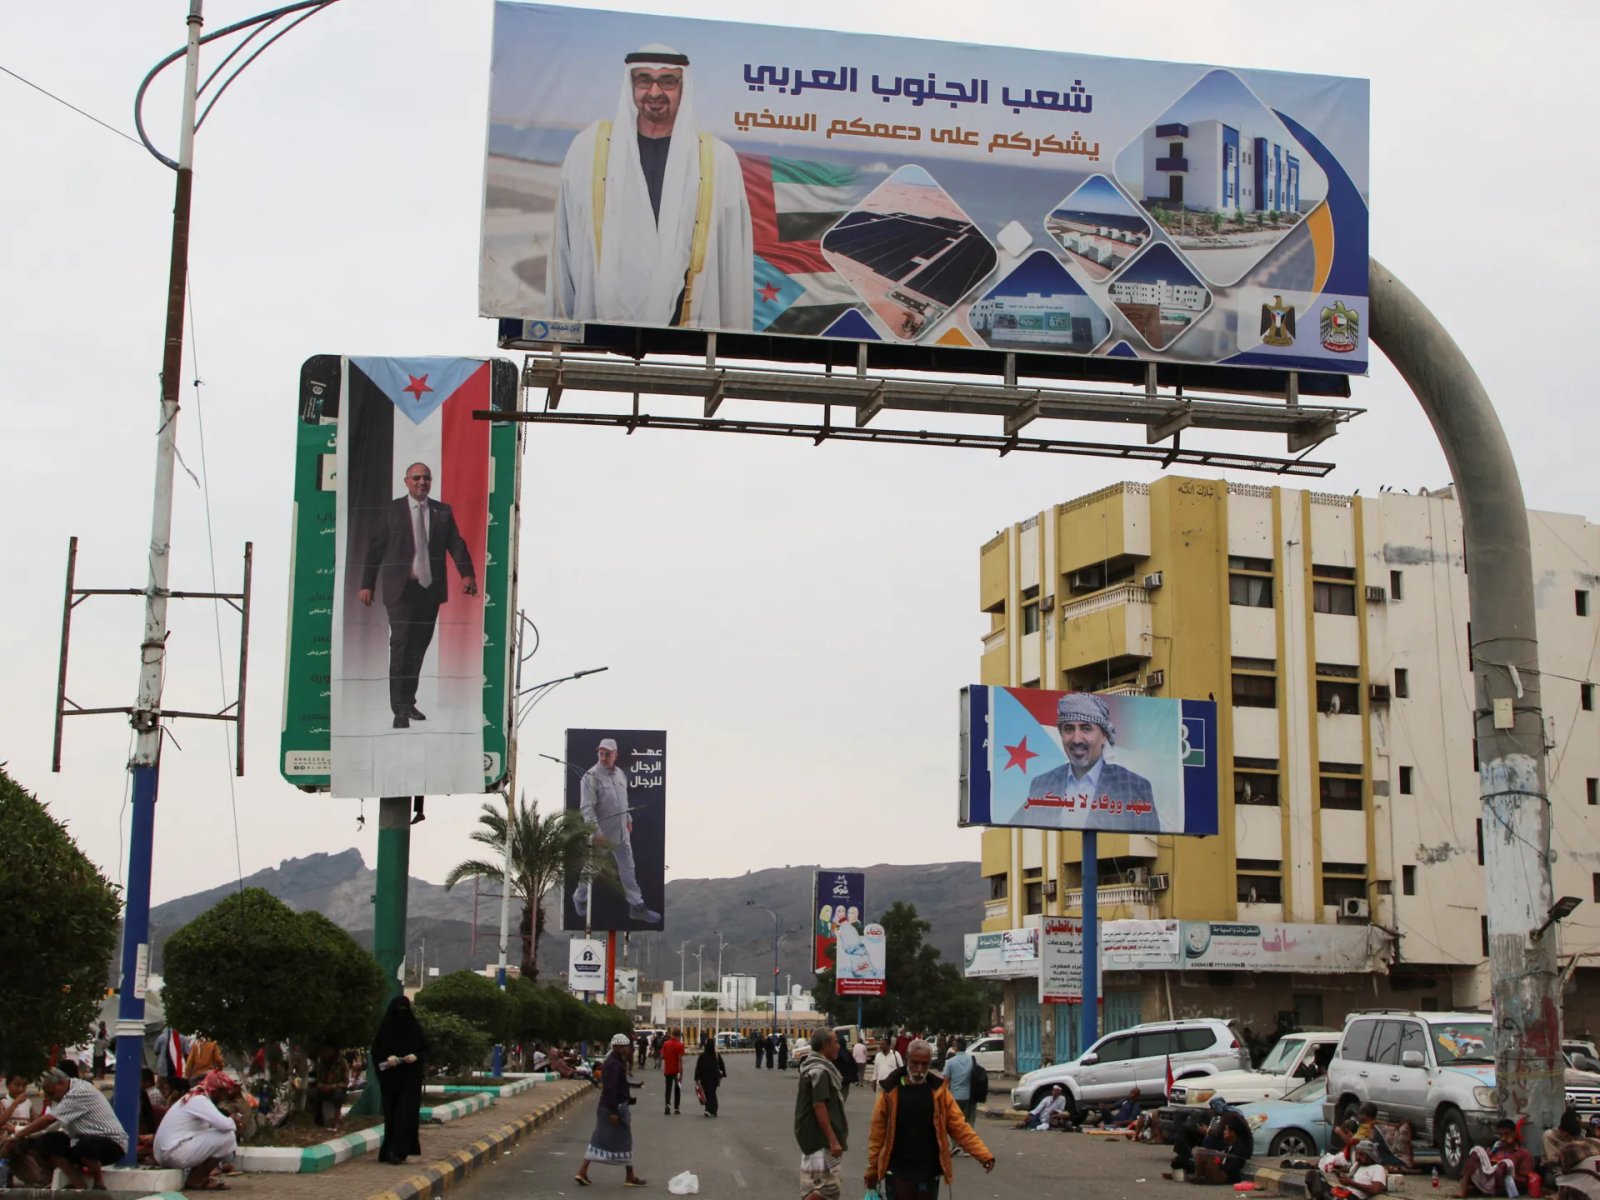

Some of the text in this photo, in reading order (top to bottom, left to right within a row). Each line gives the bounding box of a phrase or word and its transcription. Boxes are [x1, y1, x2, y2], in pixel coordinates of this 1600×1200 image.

[743, 63, 1093, 114] شعب الجنوب العربي
[734, 108, 1101, 162] يشكركم على دعمكم السخي
[630, 748, 663, 756] عهد
[630, 760, 662, 773] الرجال
[630, 775, 663, 788] للرجال
[1024, 791, 1075, 812] ينكسر
[1078, 793, 1089, 808] لا
[1091, 792, 1123, 814] ووفاء
